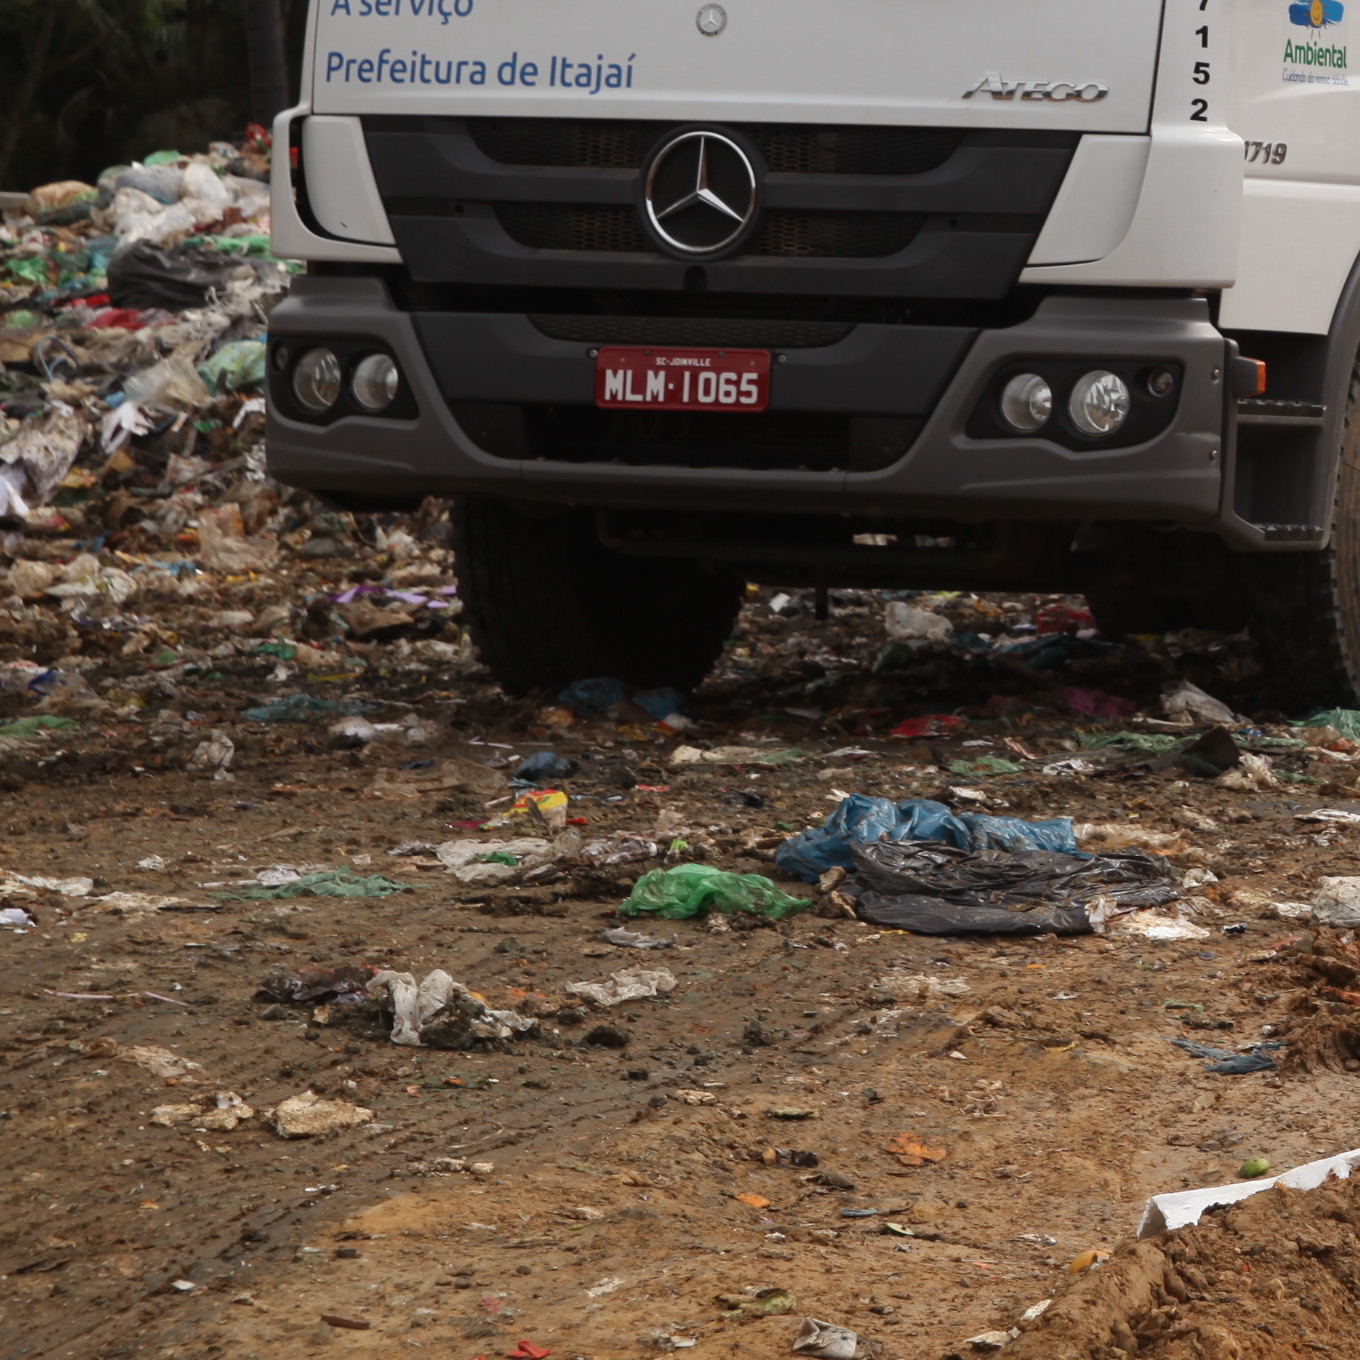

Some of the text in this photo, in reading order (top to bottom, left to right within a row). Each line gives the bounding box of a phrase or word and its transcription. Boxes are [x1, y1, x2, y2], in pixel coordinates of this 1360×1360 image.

[1283, 37, 1347, 69] Ambiental
[325, 48, 637, 95] Prefeitura de Itajaí
[961, 71, 1110, 103] ATEGO
